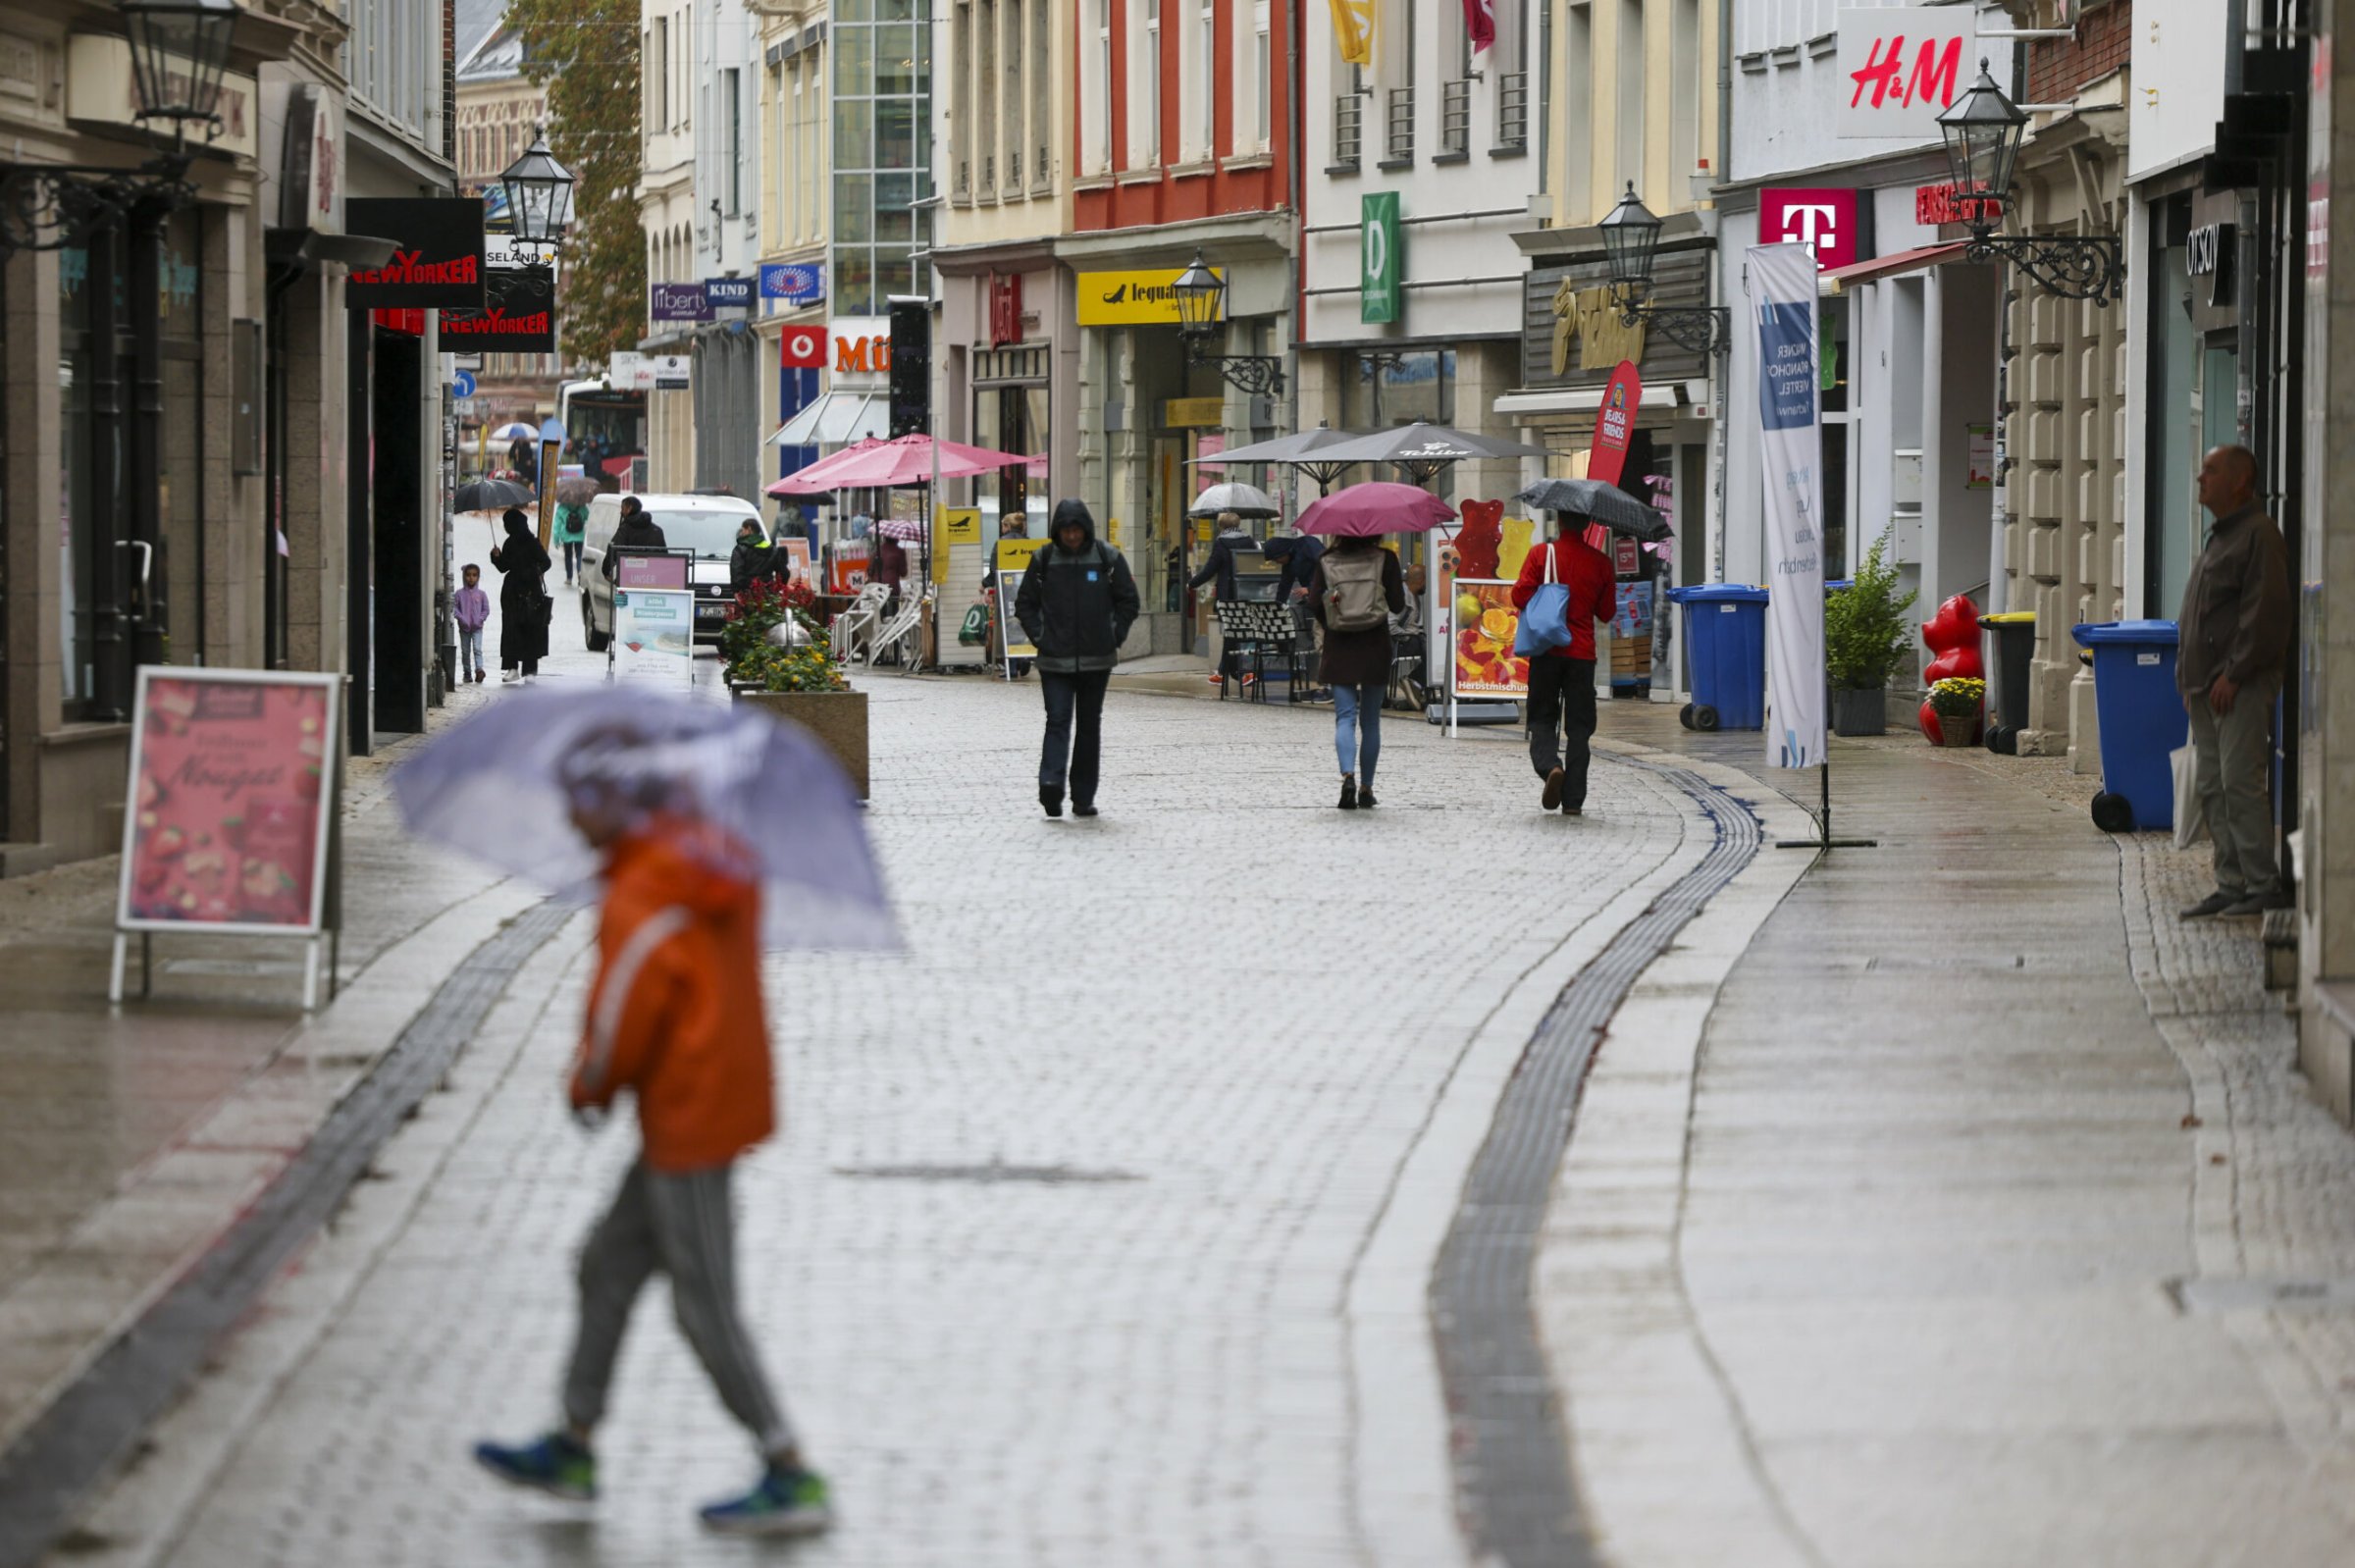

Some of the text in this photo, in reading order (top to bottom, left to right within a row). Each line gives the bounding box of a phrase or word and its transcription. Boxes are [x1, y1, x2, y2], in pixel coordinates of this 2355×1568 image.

[1851, 35, 1963, 109] H&M
[2186, 224, 2220, 307] orsay
[709, 285, 748, 296] KIND
[967, 610, 980, 627] D
